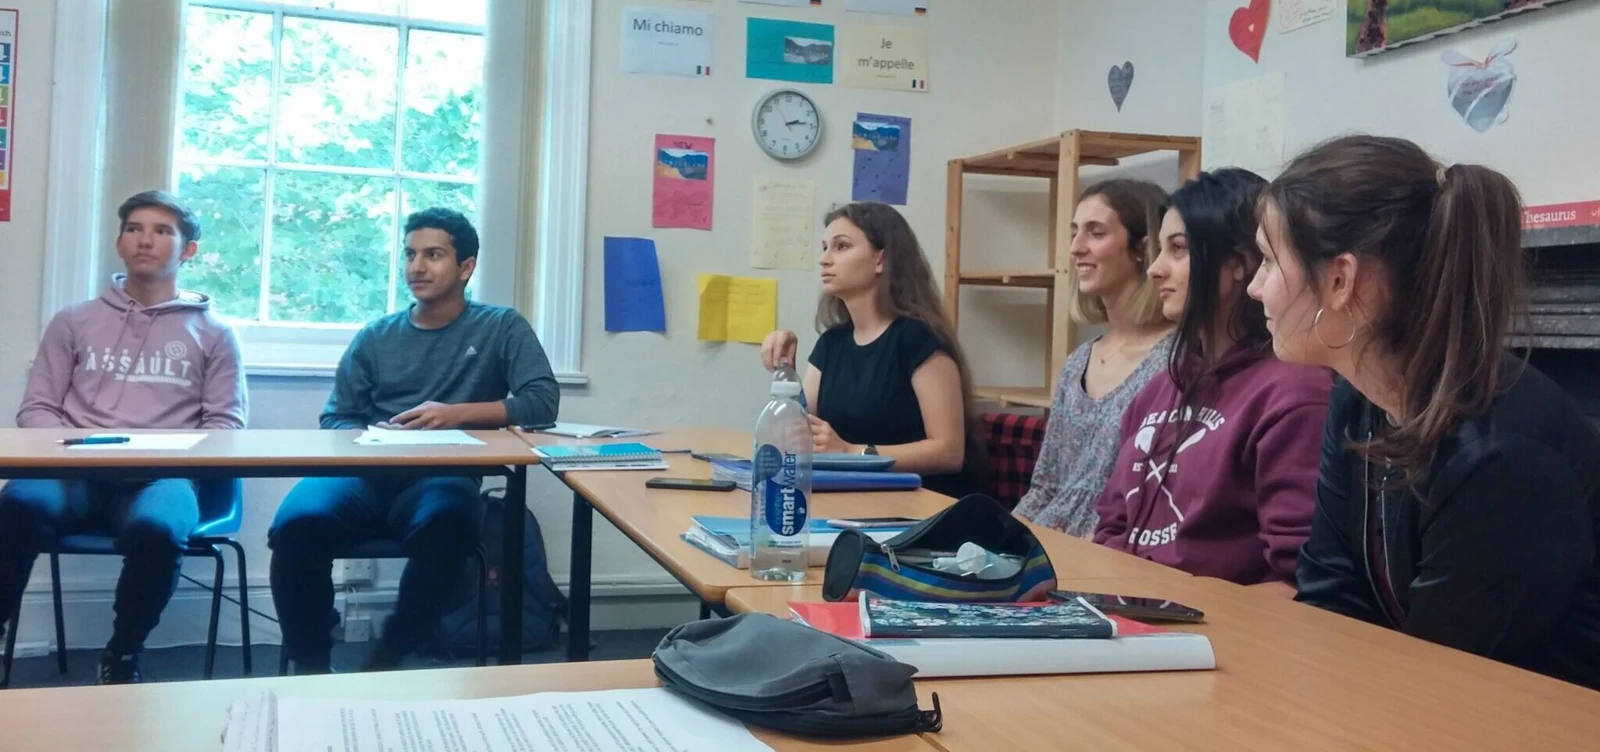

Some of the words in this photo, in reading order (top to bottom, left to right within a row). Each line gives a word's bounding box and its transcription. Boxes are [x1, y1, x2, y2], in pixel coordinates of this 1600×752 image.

[633, 19, 651, 31] Mi
[655, 20, 703, 36] chiamo
[881, 37, 892, 49] Je
[86, 352, 191, 377] ASSAULT
